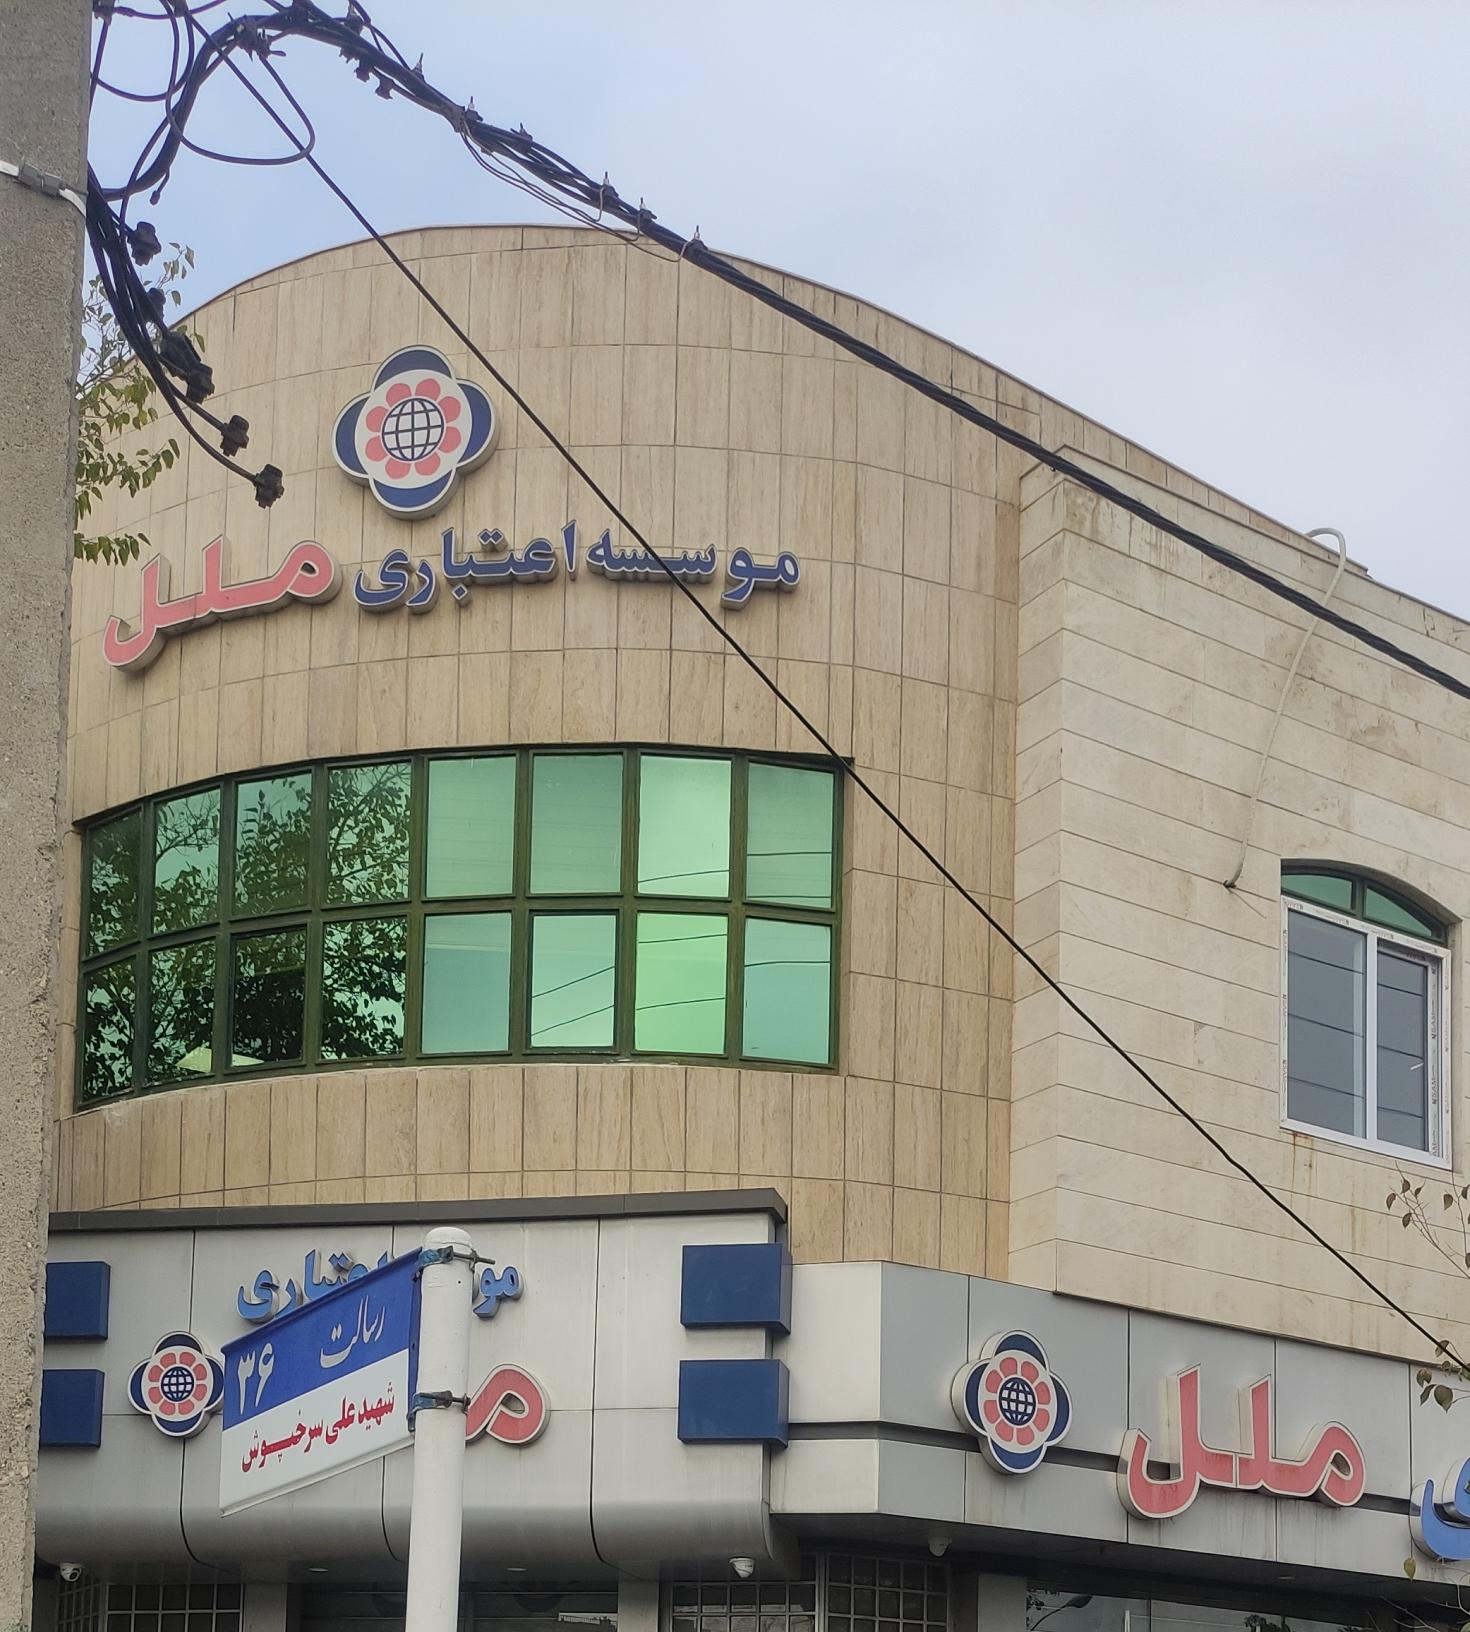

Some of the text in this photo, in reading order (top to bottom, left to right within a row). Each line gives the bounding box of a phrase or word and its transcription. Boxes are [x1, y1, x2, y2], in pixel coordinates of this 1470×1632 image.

[103, 518, 801, 669] موسسه اعتباری ملل
[237, 1294, 386, 1416] رسالت ۳۶
[242, 1382, 395, 1472] شهید علی سرخپوش
[1120, 1364, 1367, 1520] ملل
